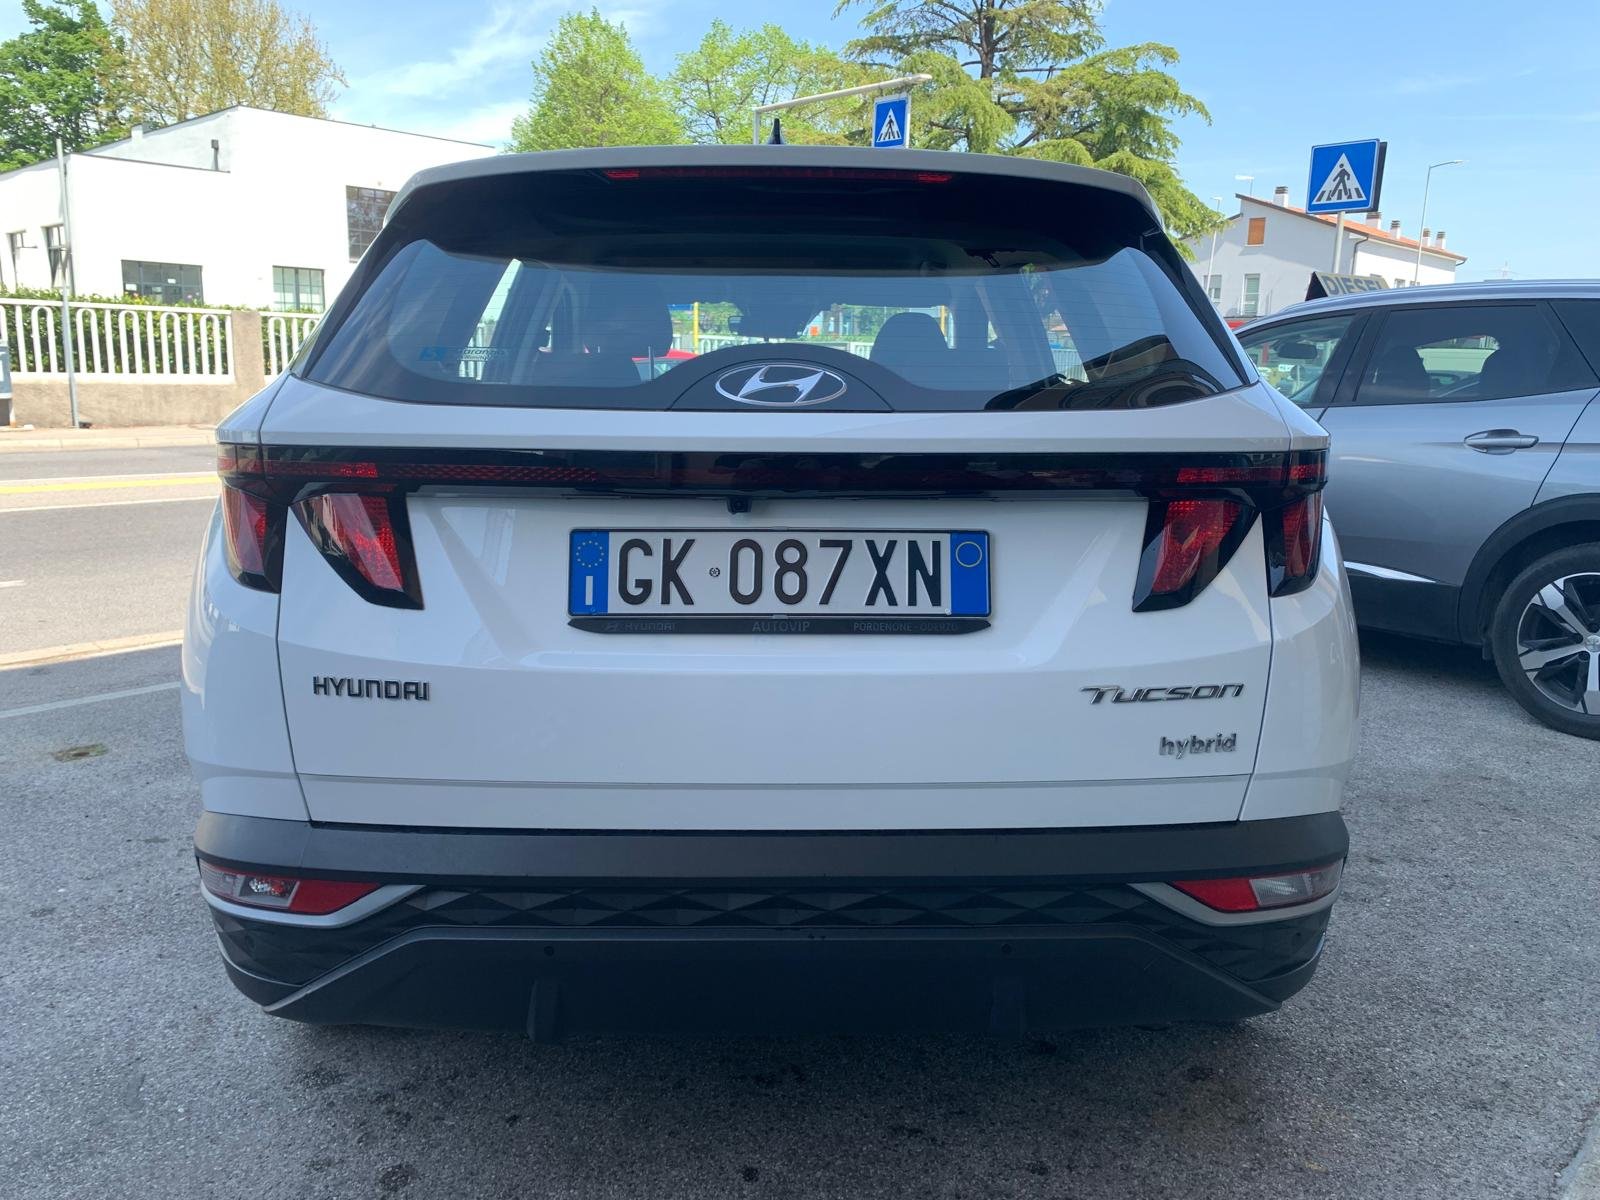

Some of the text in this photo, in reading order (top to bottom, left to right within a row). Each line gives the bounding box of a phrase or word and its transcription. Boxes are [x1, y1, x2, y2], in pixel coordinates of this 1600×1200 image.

[618, 538, 696, 606] GK
[624, 622, 676, 631] HYUNDAI
[751, 621, 810, 632] AUTOVIP
[853, 622, 913, 632] PORDENONE
[313, 676, 430, 701] HYUNDAI
[1159, 732, 1237, 759] hybrid
